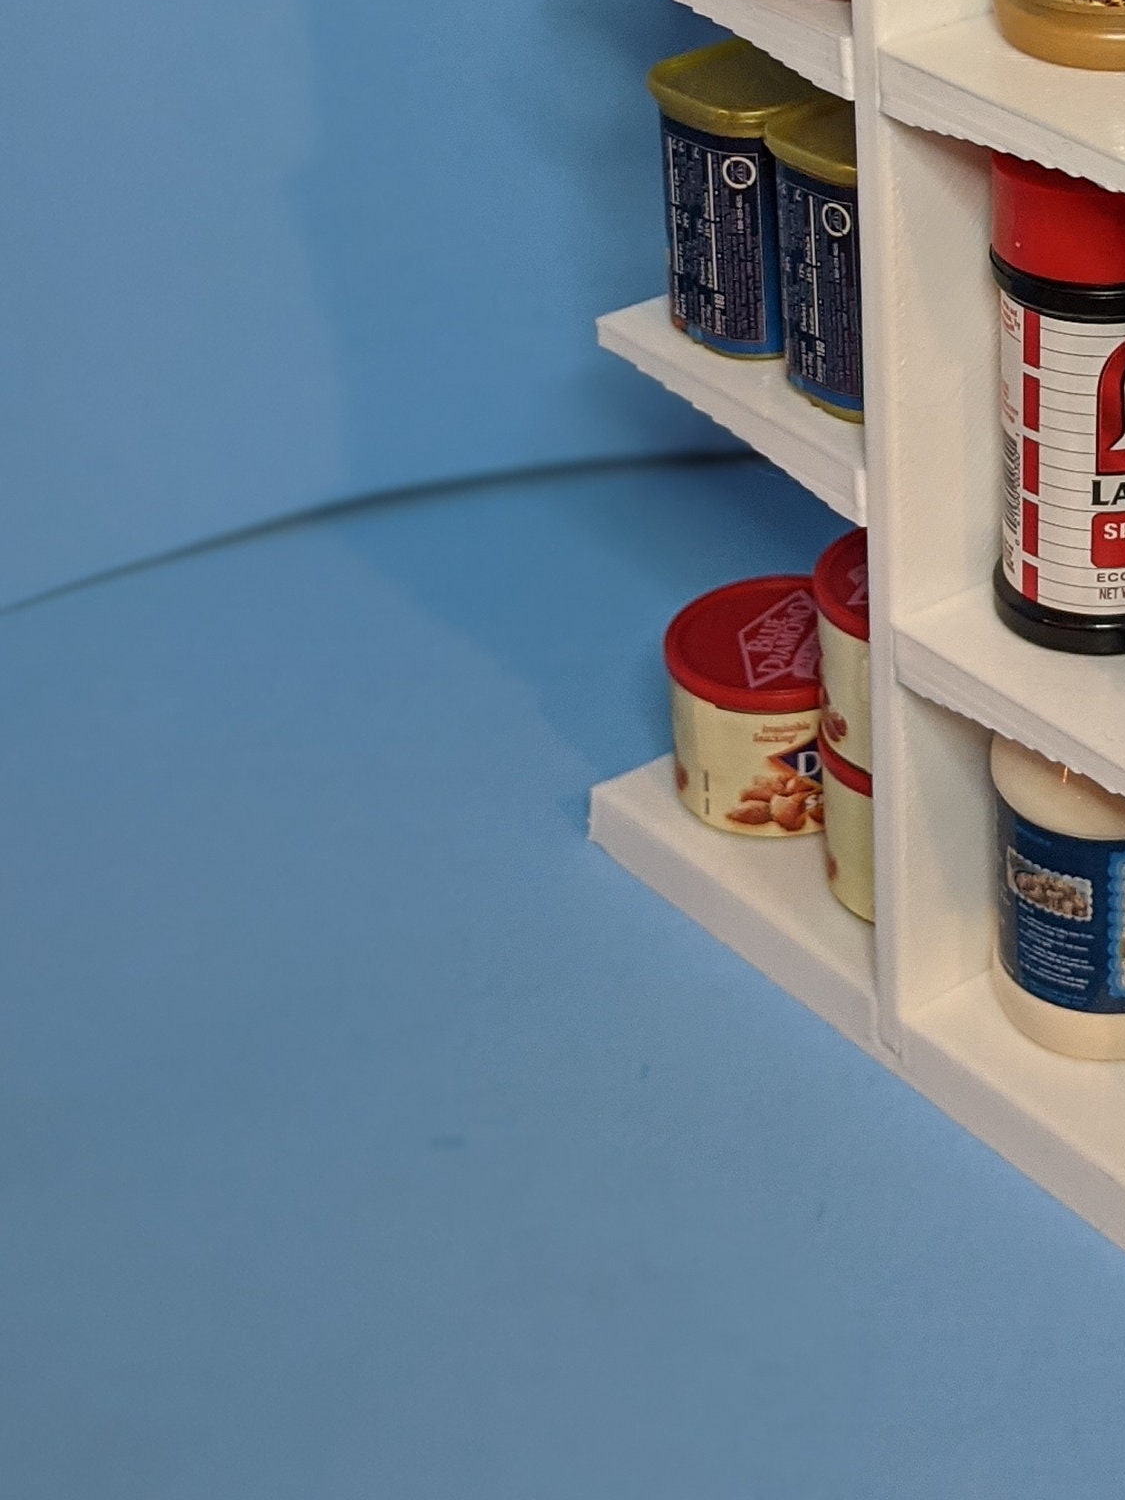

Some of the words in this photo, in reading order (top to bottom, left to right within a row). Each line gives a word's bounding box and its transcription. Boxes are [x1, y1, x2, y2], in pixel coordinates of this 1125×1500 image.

[1100, 586, 1119, 600] NET
[744, 615, 786, 651] BLUE
[756, 600, 813, 672] DIAMOND
